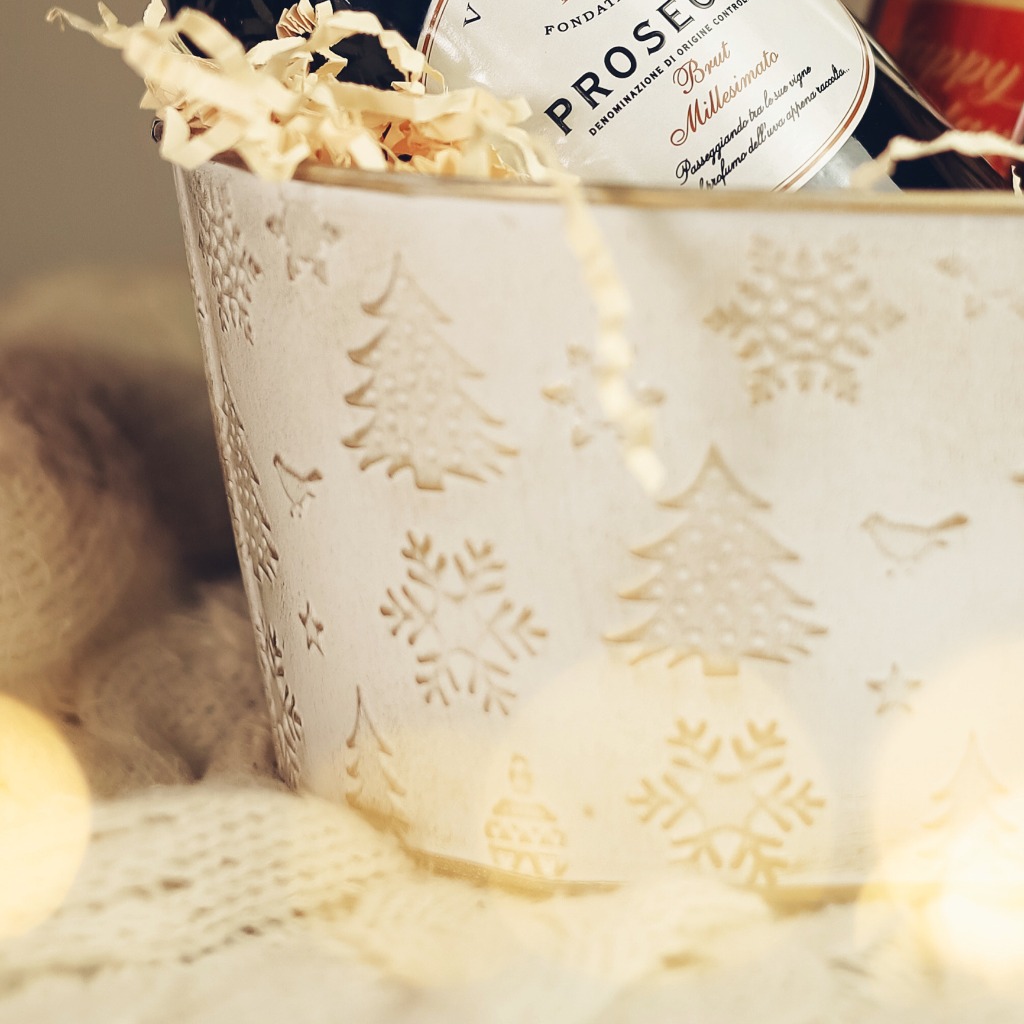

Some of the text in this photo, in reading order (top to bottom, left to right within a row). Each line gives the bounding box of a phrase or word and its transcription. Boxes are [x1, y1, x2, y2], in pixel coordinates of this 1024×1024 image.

[589, 66, 665, 137] DENOMINAZIONE
[664, 54, 677, 68] DI
[677, 24, 713, 57] ORIGINE
[670, 50, 779, 146] Millesimato
[672, 41, 731, 94] Brut
[786, 91, 817, 122] appena
[675, 66, 812, 186] Passeggiando tra le sue vigne
